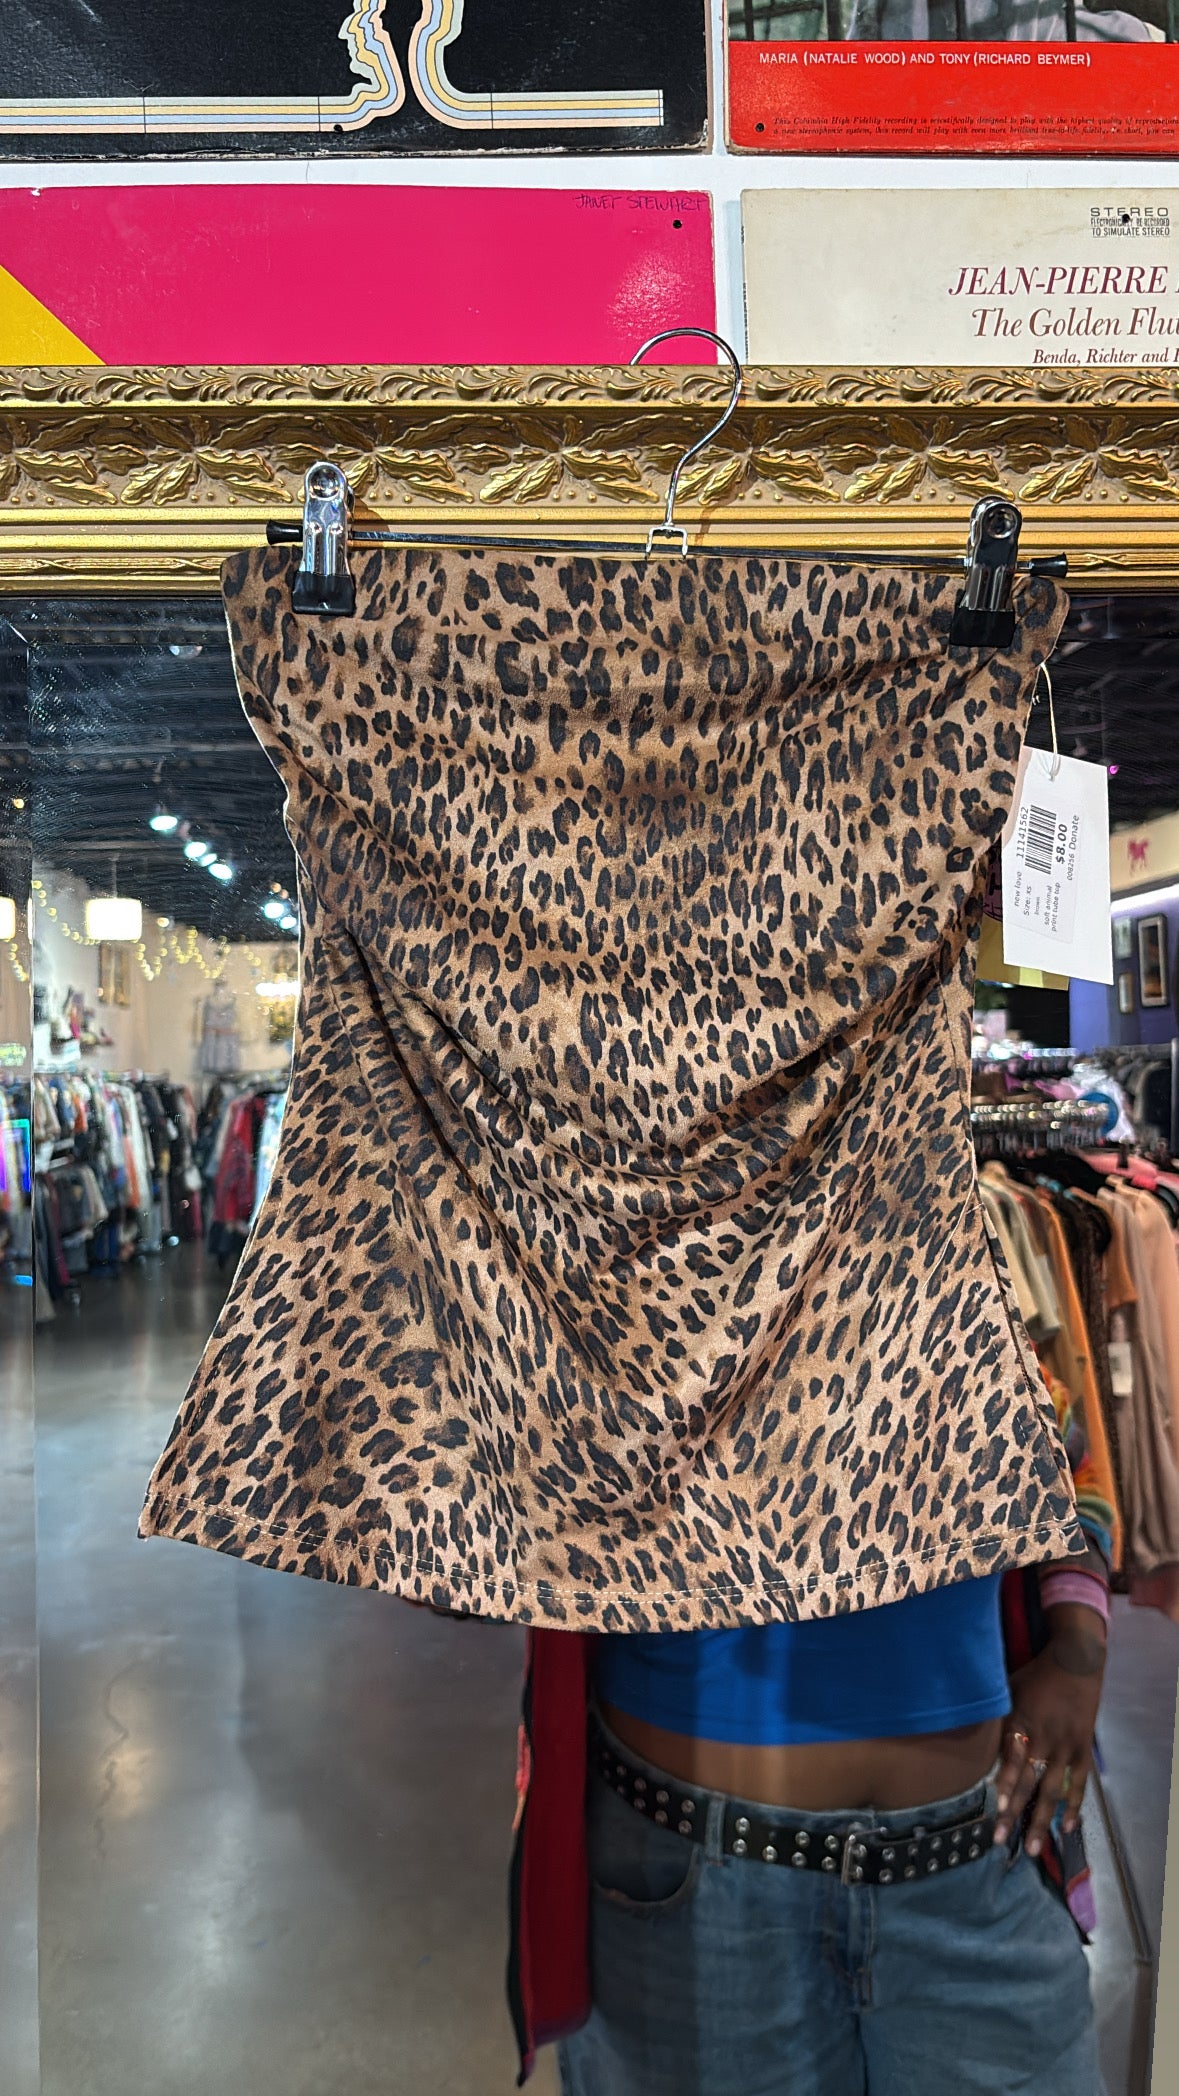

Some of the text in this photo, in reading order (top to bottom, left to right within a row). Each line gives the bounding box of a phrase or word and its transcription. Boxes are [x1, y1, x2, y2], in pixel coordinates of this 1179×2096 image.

[759, 51, 1091, 67] MARIA (NATALIE WOOD) AND TONY (RICHARD BEYMER)
[774, 117, 791, 125] This
[793, 117, 828, 126] Columbia
[831, 117, 850, 126] High
[853, 117, 881, 126] Fidelity
[884, 117, 917, 126] recording
[930, 117, 974, 126] scientifically
[977, 116, 1007, 126] designed
[1010, 117, 1017, 125] to
[1020, 117, 1036, 126] play
[1039, 116, 1054, 125] with
[1056, 117, 1067, 125] the
[1070, 117, 1095, 126] highest
[799, 127, 843, 136] stereophonic
[846, 128, 872, 137] system,
[875, 127, 889, 135] this
[891, 127, 914, 135] record
[916, 127, 931, 135] will
[934, 127, 950, 136] play
[952, 127, 968, 135] with
[1009, 127, 1039, 135] brilliant
[575, 193, 709, 212] JANET STEWART
[1090, 207, 1169, 217] STEREO
[1092, 227, 1170, 236] TO SIMULATE STEREO
[948, 266, 1168, 296] JEAN-PIERRE
[972, 307, 1022, 337] The
[1029, 306, 1122, 337] Golden
[1032, 349, 1081, 367] Benda,
[1085, 348, 1137, 364] Richter
[1141, 347, 1169, 363] and
[1016, 806, 1029, 859] 11141562
[1056, 823, 1068, 865] $8.00
[1066, 815, 1080, 881] 008256 Donate
[1023, 897, 1032, 916] Size:
[1045, 885, 1053, 910] animal
